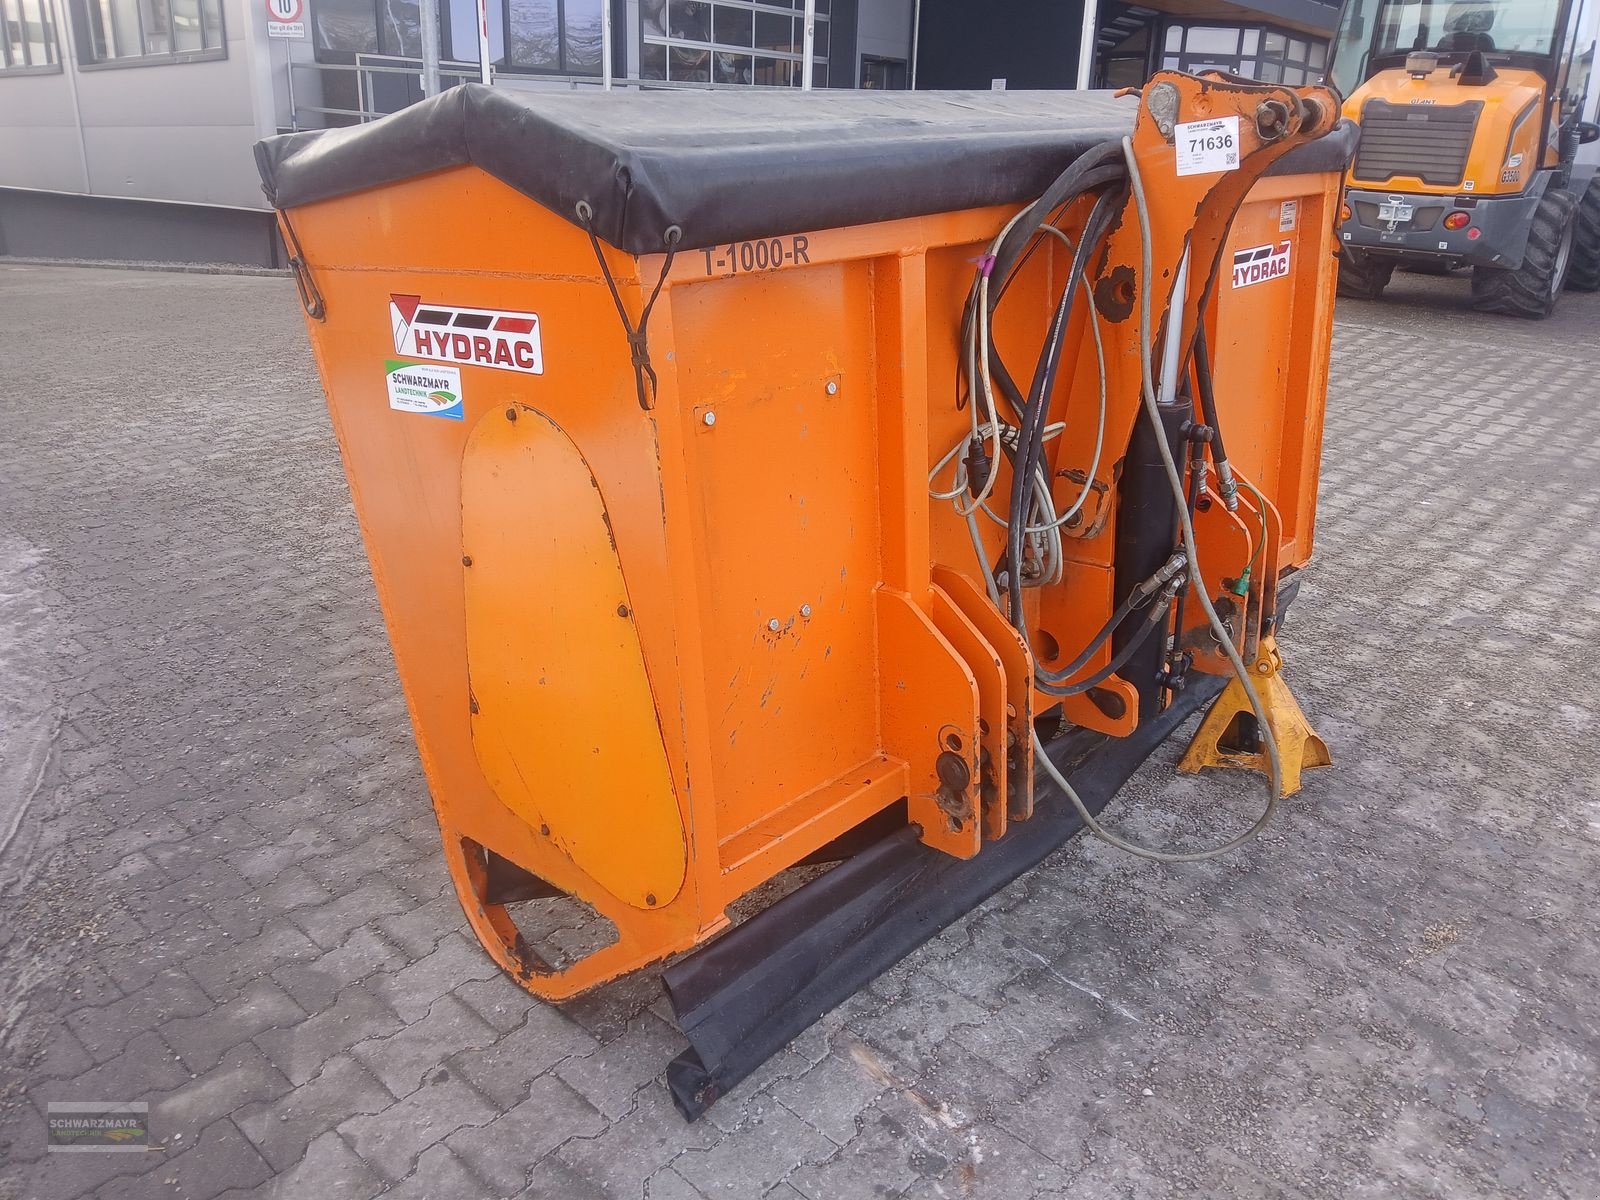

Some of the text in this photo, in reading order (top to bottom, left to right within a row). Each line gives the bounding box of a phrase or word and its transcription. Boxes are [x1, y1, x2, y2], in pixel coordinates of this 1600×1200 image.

[279, 0, 291, 13] 10
[1189, 134, 1233, 153] 71636
[699, 235, 810, 276] T-1000-R
[414, 329, 535, 369] HYDRAC
[392, 373, 450, 390] SCHWARZMAYR
